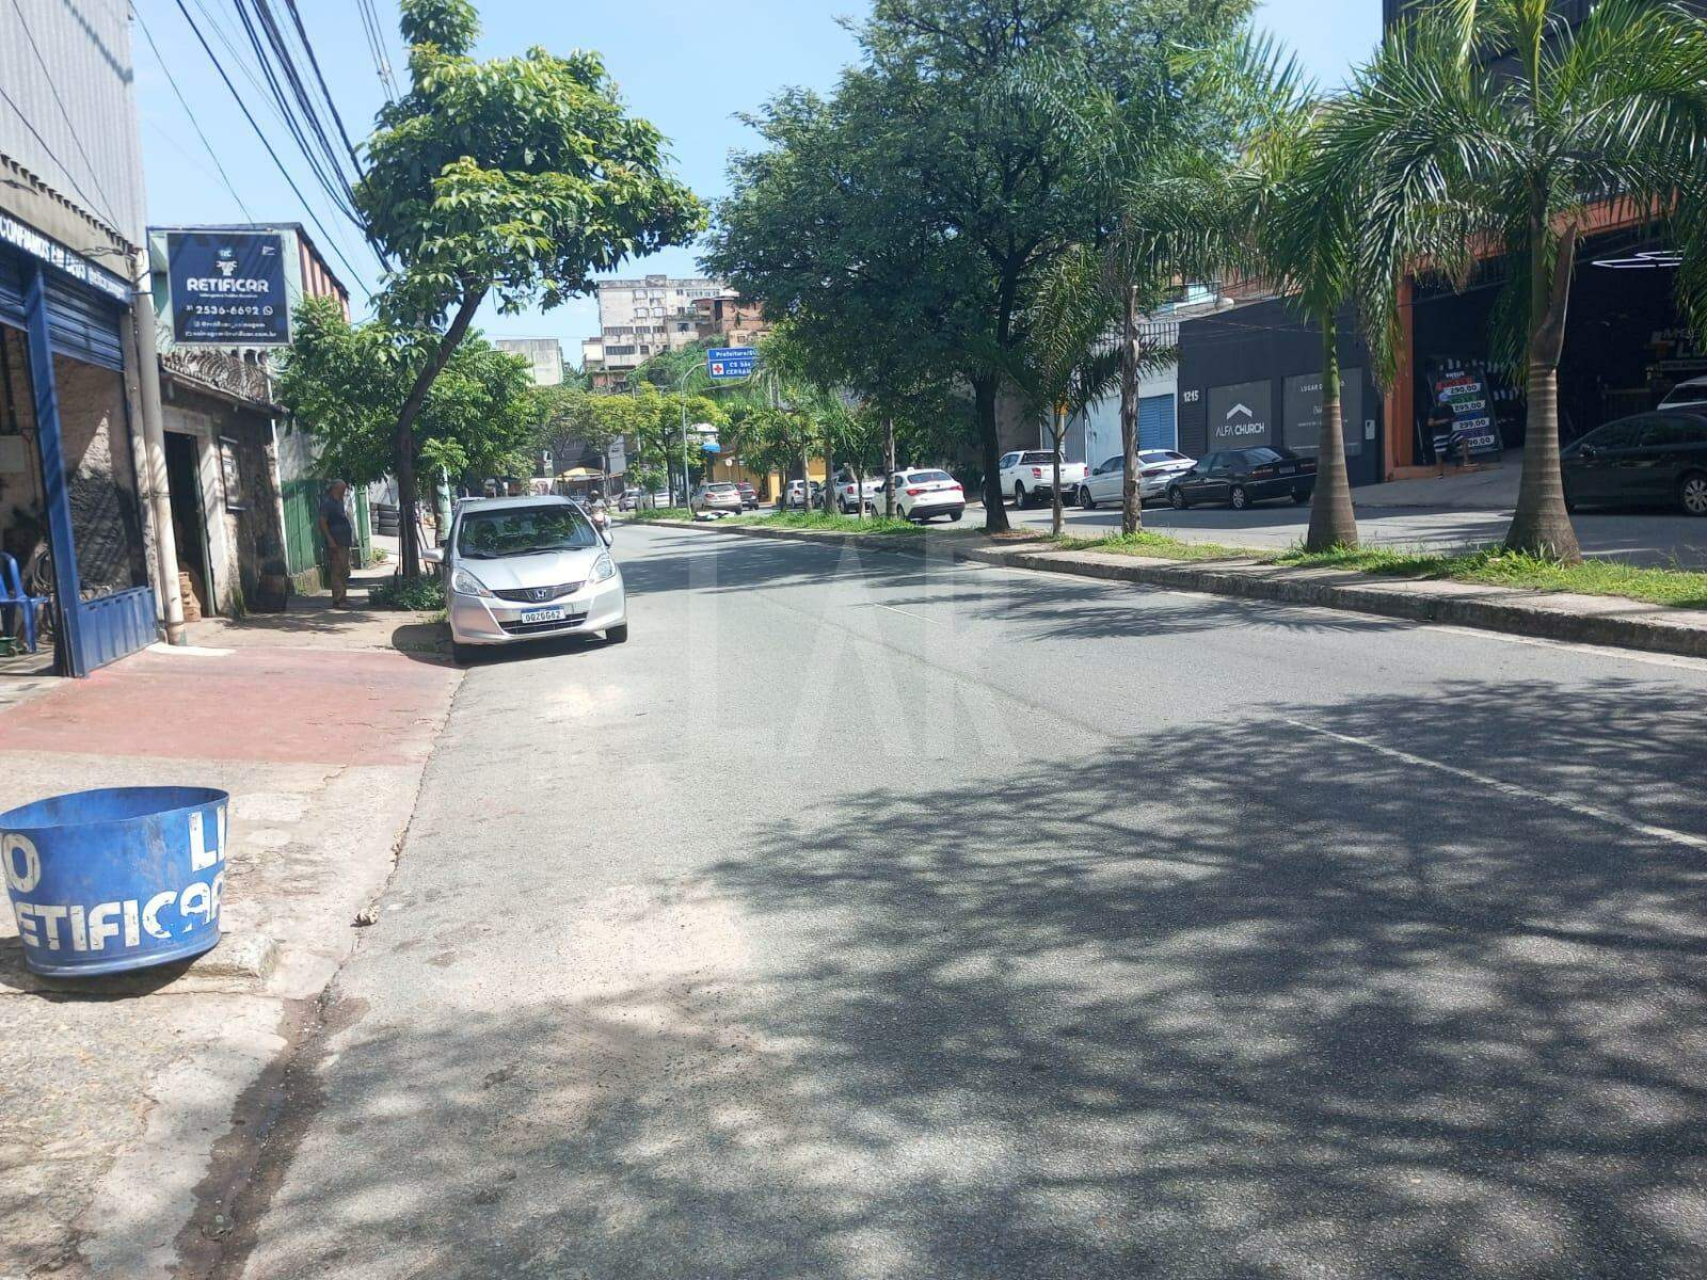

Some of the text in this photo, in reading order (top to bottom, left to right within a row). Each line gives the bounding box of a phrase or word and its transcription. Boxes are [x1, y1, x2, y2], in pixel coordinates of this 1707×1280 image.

[186, 278, 270, 293] RETIFICAR
[196, 305, 260, 316] 2536-6692
[1183, 390, 1199, 403] 1215
[1215, 422, 1265, 438] ALFA CHURCH
[0, 833, 41, 893] O
